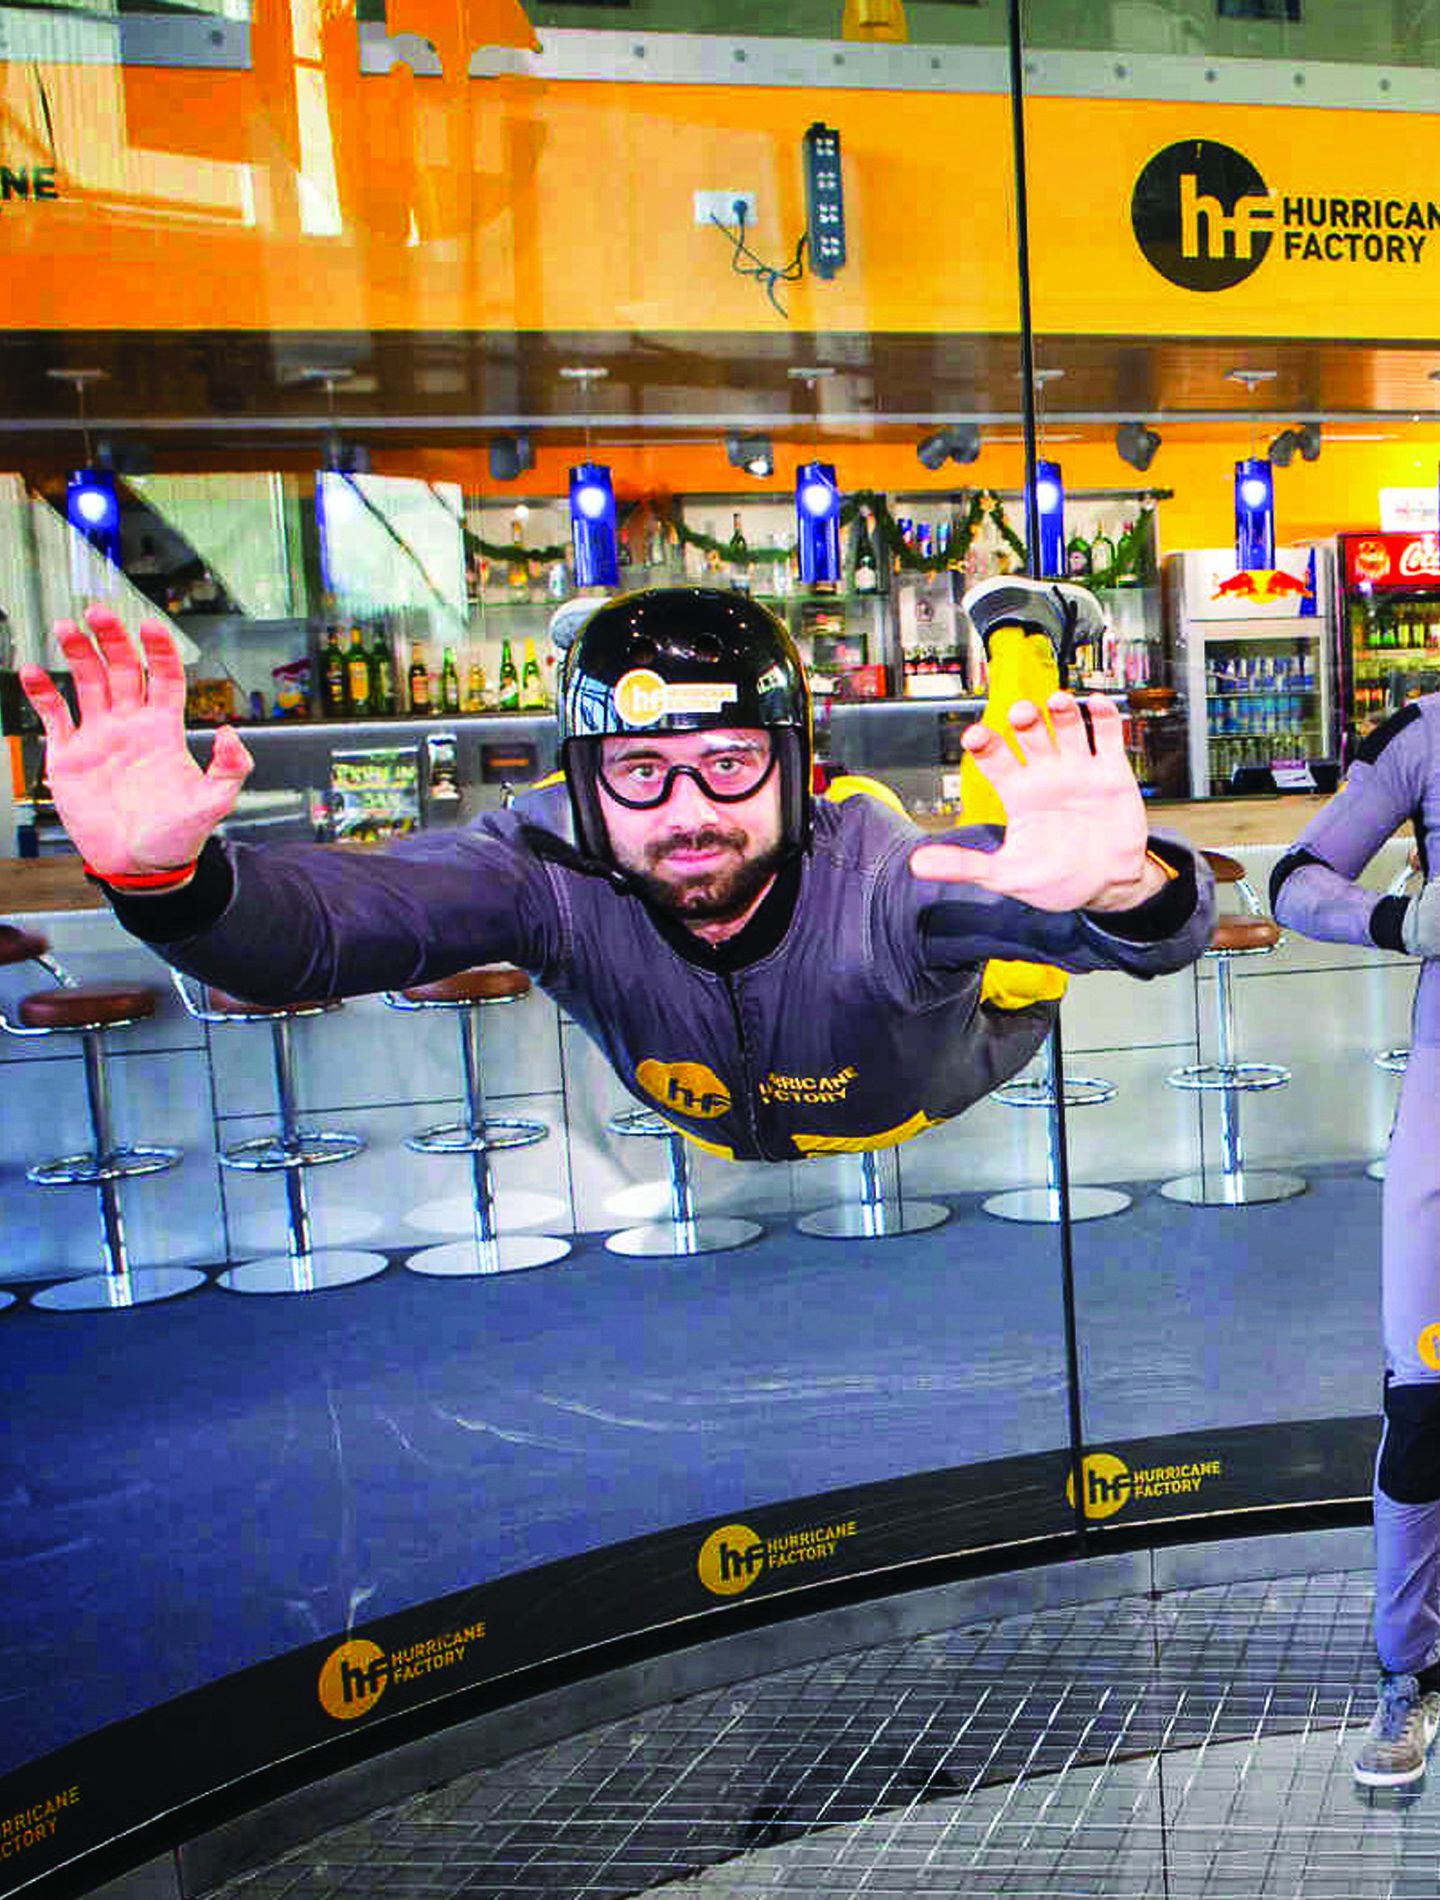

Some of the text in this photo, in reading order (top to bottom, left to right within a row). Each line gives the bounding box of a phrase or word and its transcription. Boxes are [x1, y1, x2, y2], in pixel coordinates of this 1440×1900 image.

[1180, 174, 1276, 258] hf
[1284, 232, 1427, 262] FACTORY
[1133, 1461, 1221, 1484] HURRICANE
[1134, 1478, 1201, 1499] FACTORY
[767, 1521, 858, 1553] HURRICANE
[768, 1540, 837, 1569] FACTORY
[719, 1542, 765, 1580] hf
[391, 1621, 487, 1667] HURRICANE
[341, 1657, 389, 1702] hf
[394, 1645, 466, 1684] FACTORY
[0, 1785, 80, 1838] RRICANE
[0, 1816, 57, 1859] CTORY
